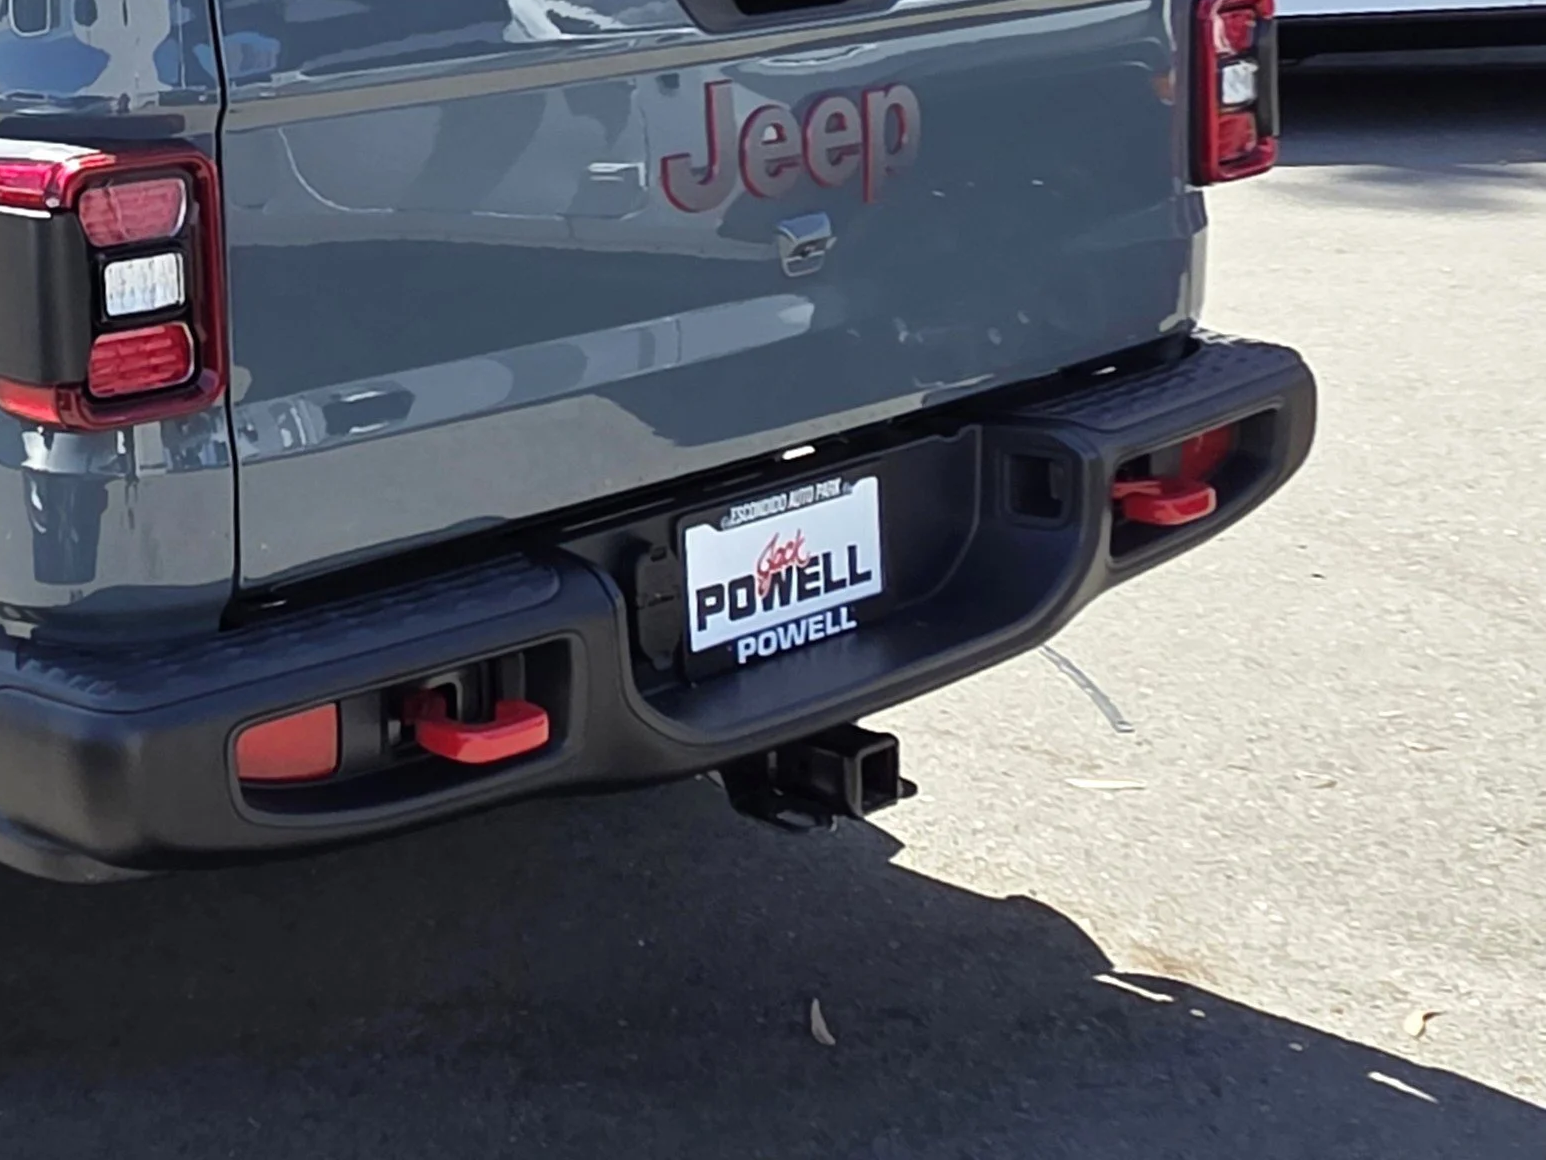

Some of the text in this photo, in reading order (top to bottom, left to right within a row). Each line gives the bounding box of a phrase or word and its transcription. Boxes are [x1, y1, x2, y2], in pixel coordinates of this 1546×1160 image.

[660, 78, 921, 213] Jeep
[729, 476, 842, 525] ESCONDIDO AUTO PARK
[696, 544, 872, 632] POWELL
[756, 528, 811, 597] Jack
[738, 607, 857, 665] POWELL
